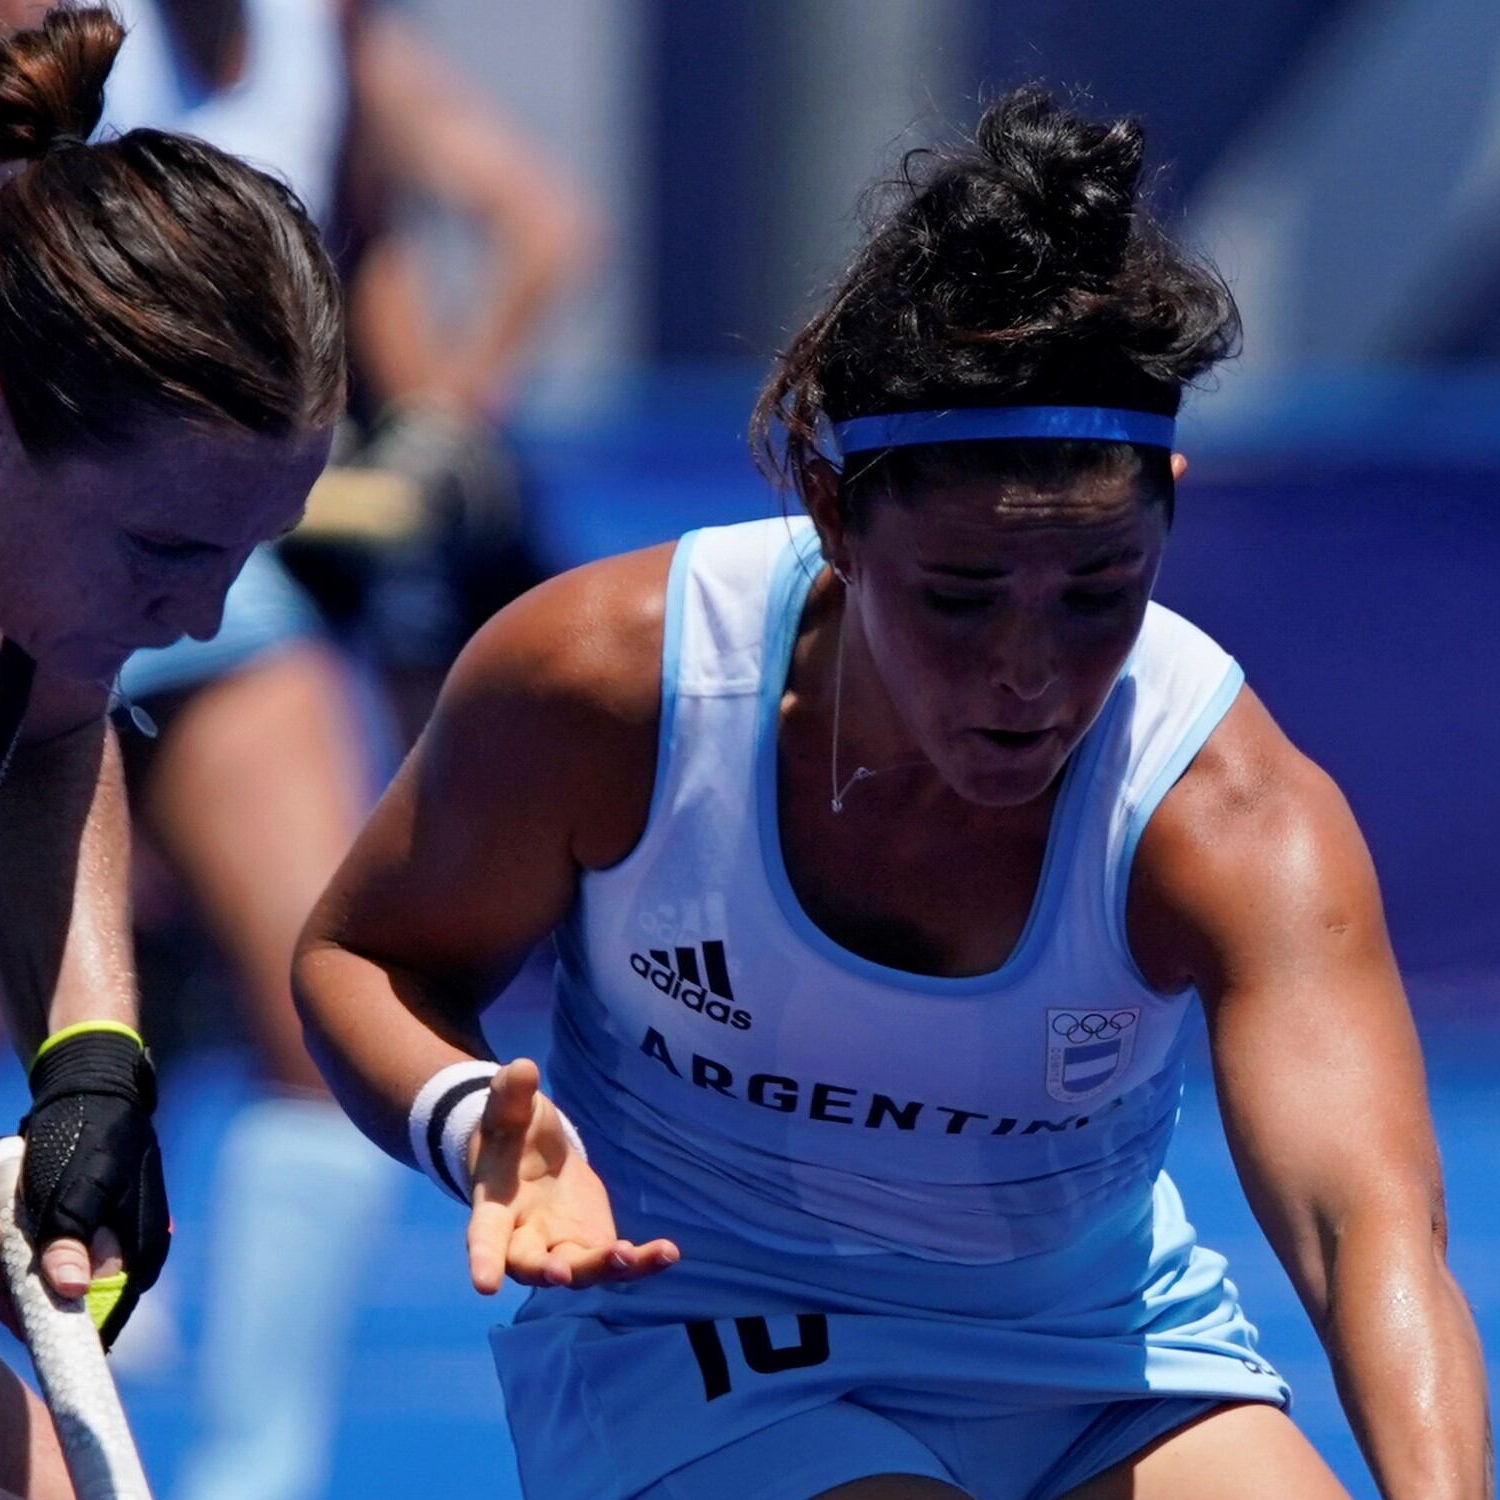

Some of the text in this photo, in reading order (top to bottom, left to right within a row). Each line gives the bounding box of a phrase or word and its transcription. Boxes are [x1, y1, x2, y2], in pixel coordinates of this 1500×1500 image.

[630, 953, 752, 1031] adidas
[639, 1026, 1091, 1136] ARGENTIN
[685, 1313, 830, 1403] 10
